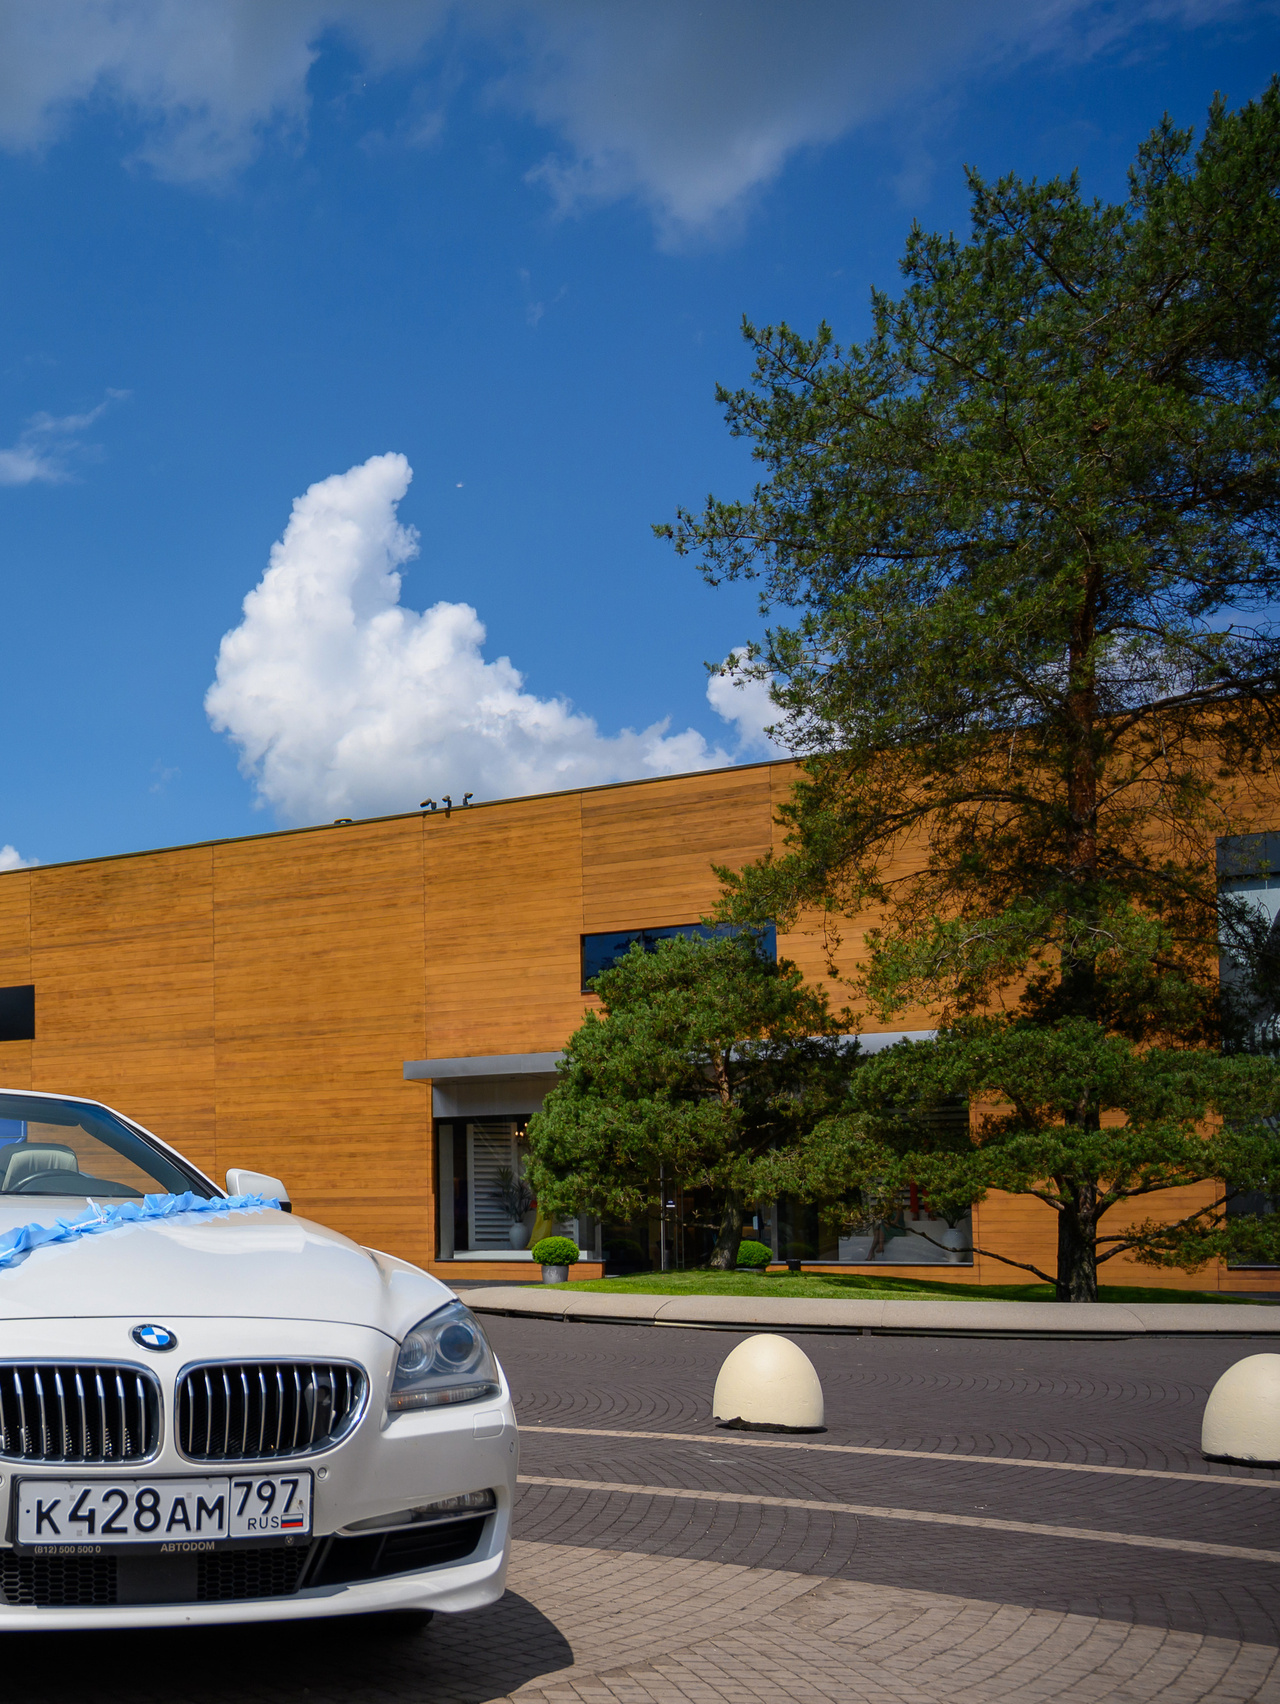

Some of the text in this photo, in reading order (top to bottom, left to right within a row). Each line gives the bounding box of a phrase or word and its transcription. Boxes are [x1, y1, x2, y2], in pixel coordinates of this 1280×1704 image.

[233, 1478, 299, 1517] 797
[247, 1516, 280, 1530] RUS
[34, 1545, 58, 1555] (812)
[59, 1545, 77, 1554] 500
[77, 1545, 95, 1554] 500
